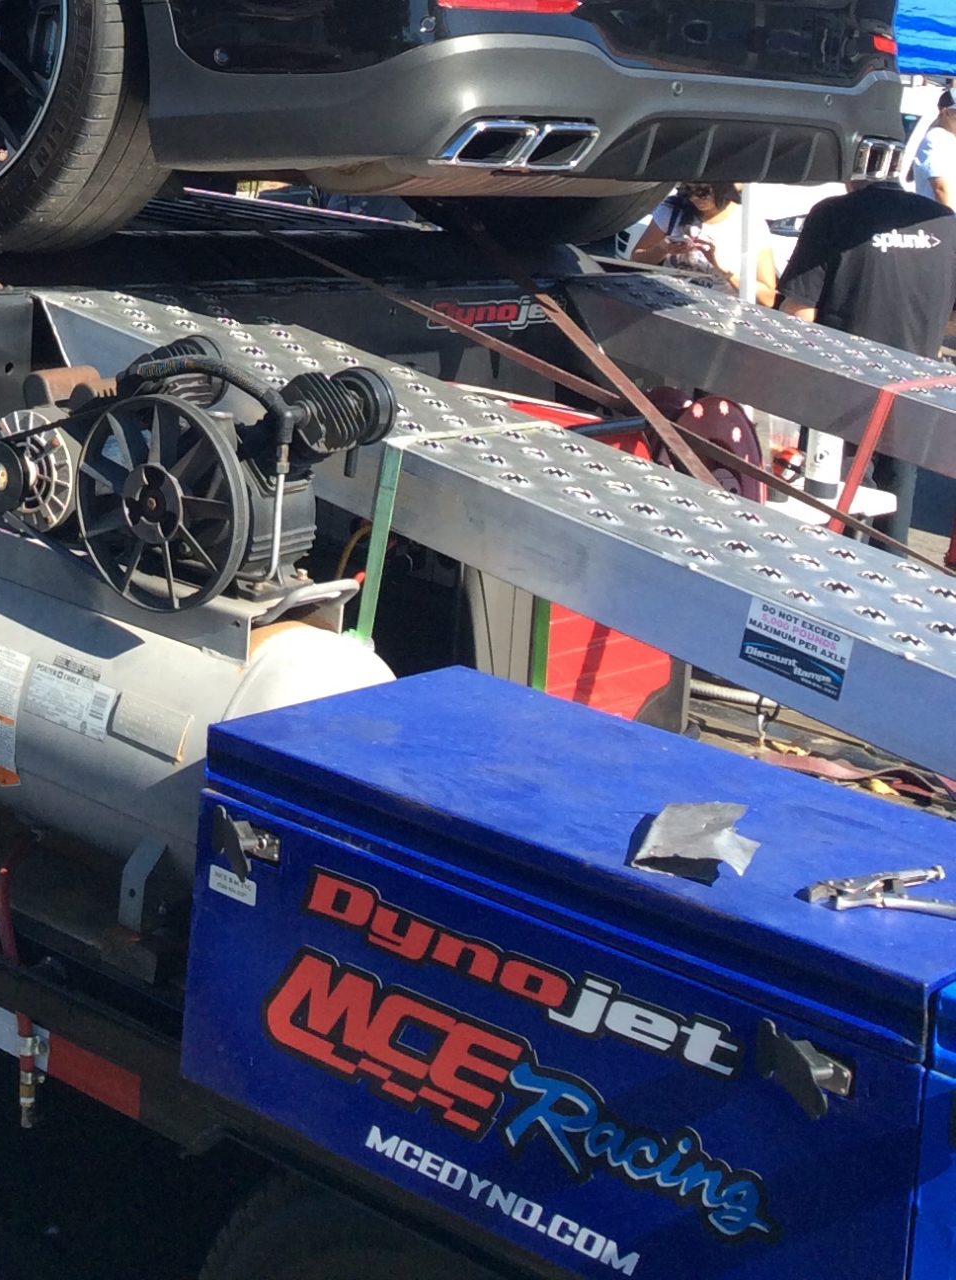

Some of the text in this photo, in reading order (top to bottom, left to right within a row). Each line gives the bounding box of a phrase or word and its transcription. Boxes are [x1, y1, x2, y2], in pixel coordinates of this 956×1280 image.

[431, 299, 548, 328] Dynoje
[749, 618, 846, 665] MAXIMUM PER AXLE
[762, 604, 841, 642] DO NOT EXCEED
[792, 625, 837, 650] POUNDS
[307, 872, 739, 1076] Dynojet
[267, 954, 770, 1236] MCE Racing
[364, 1124, 641, 1277] MCEDYNO.COM
